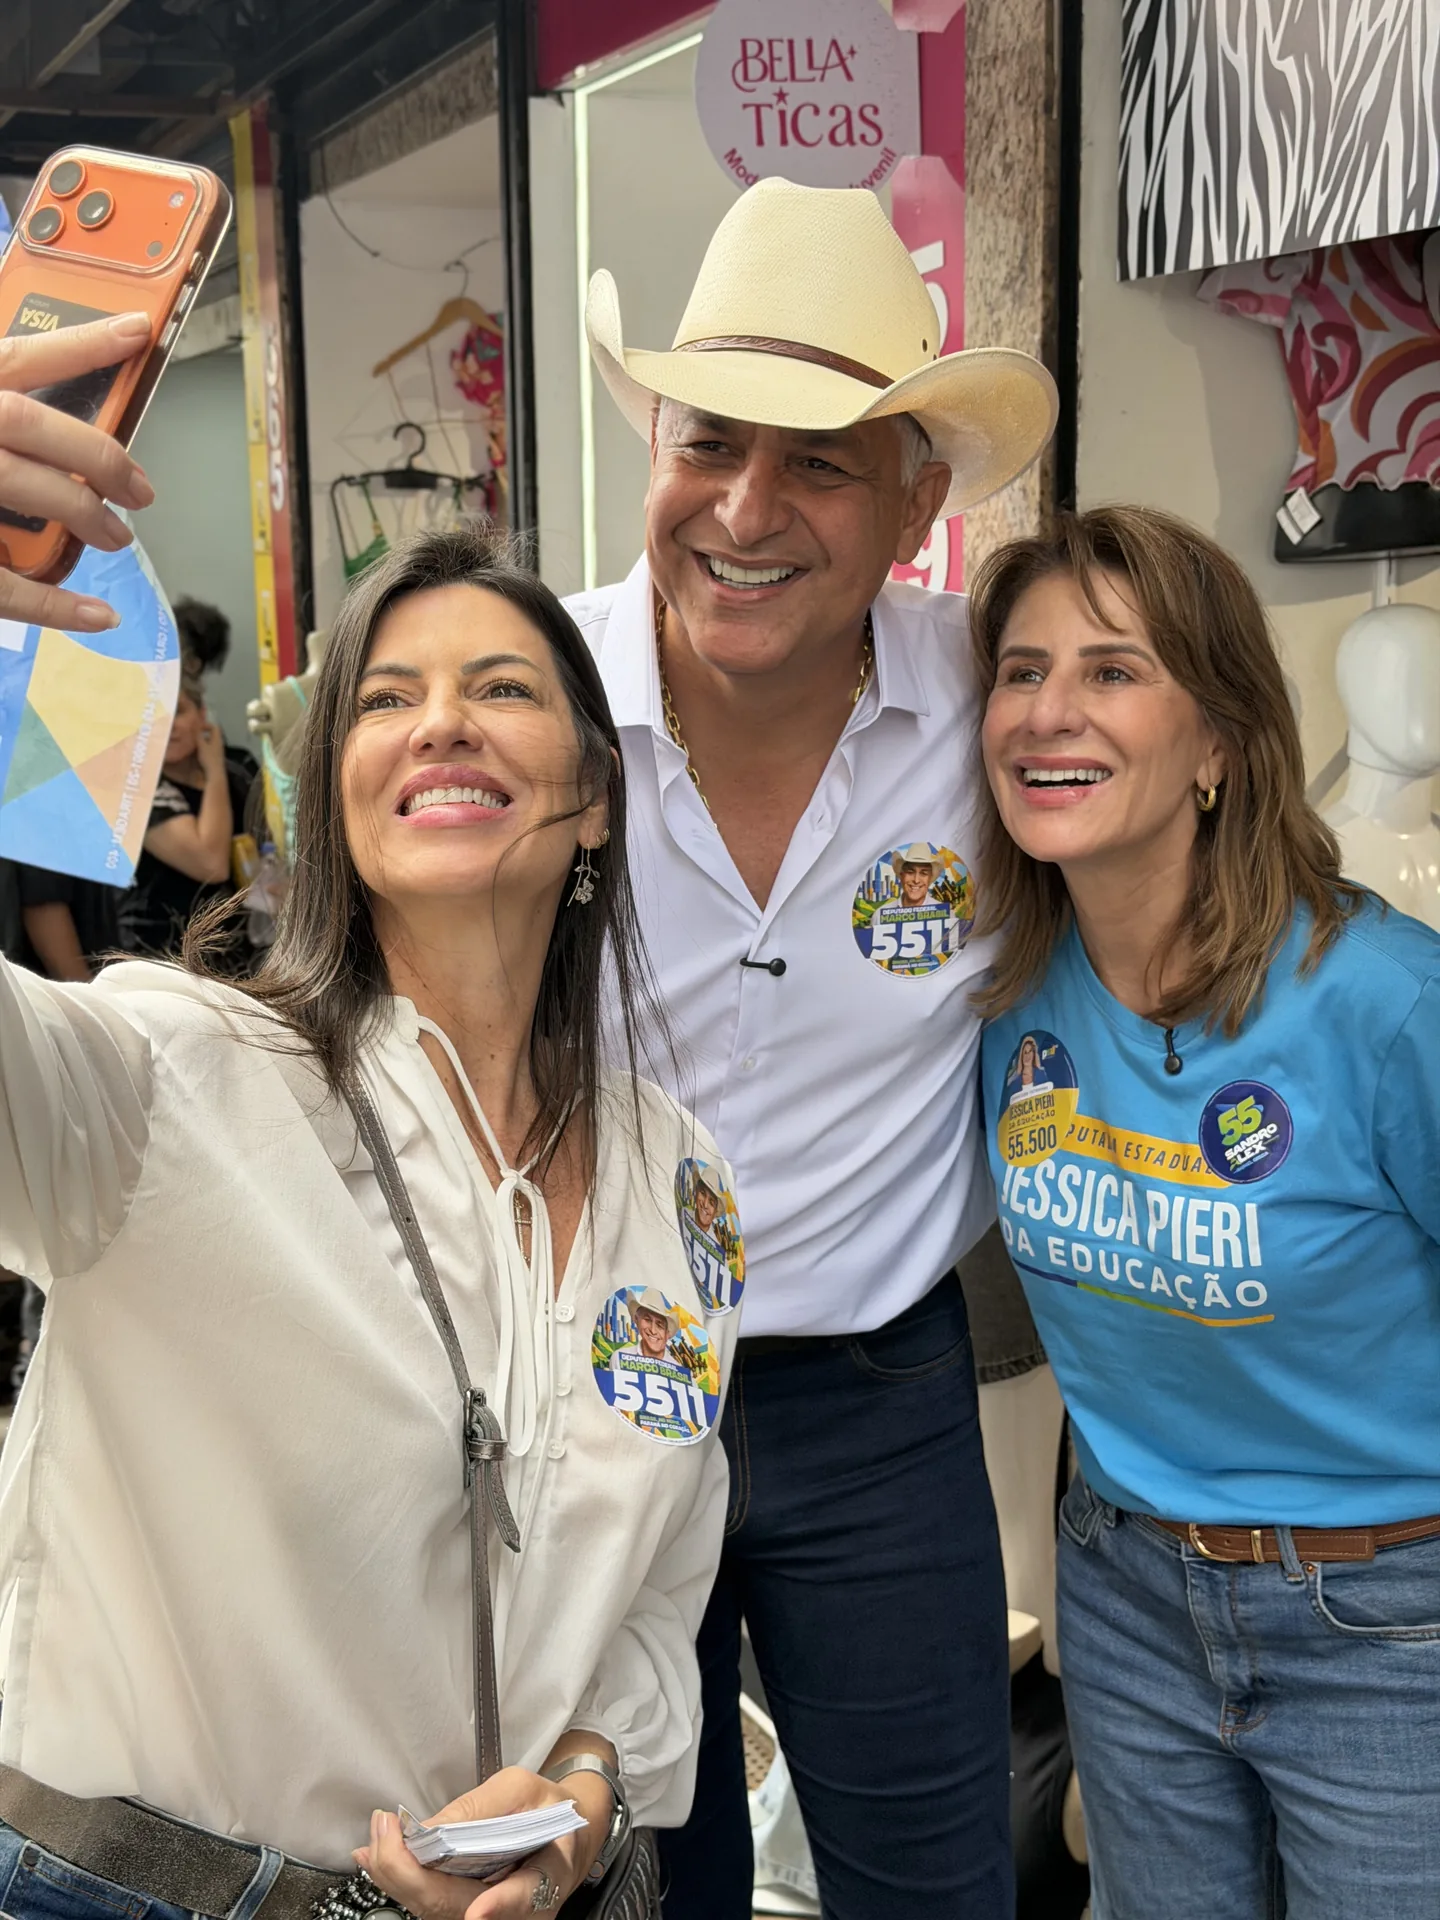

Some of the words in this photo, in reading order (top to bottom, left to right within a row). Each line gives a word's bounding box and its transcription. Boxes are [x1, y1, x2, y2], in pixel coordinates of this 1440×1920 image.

[731, 38, 854, 93] BELLA
[723, 148, 761, 187] Mod
[19, 307, 60, 332] VISA
[881, 912, 916, 923] MARCO
[917, 909, 949, 920] BRASIL
[870, 918, 960, 960] 5511
[1034, 1094, 1056, 1112] PIERI
[1217, 1095, 1262, 1146] 55
[1008, 1124, 1058, 1161] 55.500
[1224, 1122, 1278, 1161] SANDRO
[1001, 1158, 1140, 1246] JESSICA
[1146, 1189, 1262, 1268] PIERI
[1001, 1216, 1036, 1257] DA
[1047, 1235, 1268, 1310] EDUCAÇÃO
[620, 1360, 659, 1373] MARCO
[659, 1367, 692, 1384] BRASIL
[621, 1354, 654, 1364] DEPUTADO
[655, 1359, 678, 1372] FEDERAL
[613, 1369, 708, 1428] 5511
